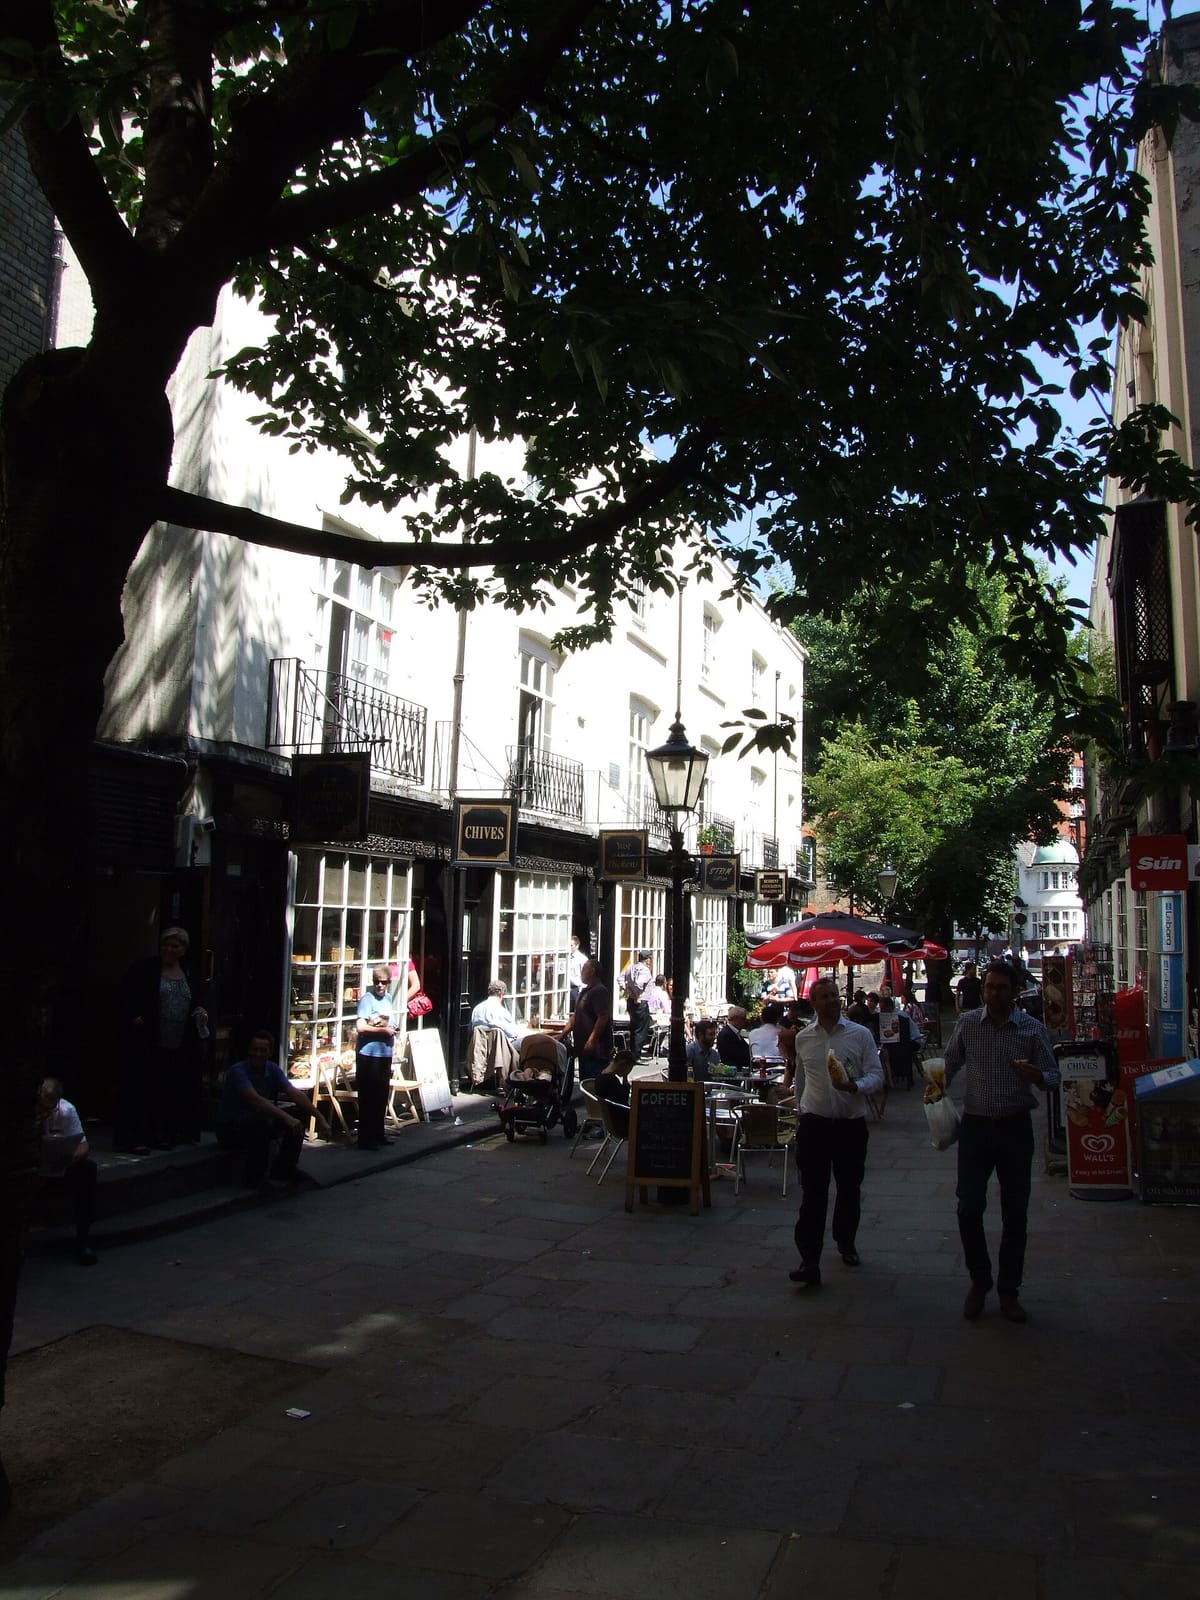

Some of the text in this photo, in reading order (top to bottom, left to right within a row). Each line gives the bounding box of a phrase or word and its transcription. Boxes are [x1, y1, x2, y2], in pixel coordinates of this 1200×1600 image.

[464, 825, 504, 840] CHIVES
[800, 939, 835, 949] Coca-Cola
[1115, 1029, 1141, 1041] un
[1067, 1062, 1098, 1071] CHIVES
[641, 1092, 688, 1106] COFFEE
[1083, 1154, 1114, 1162] WALL'S
